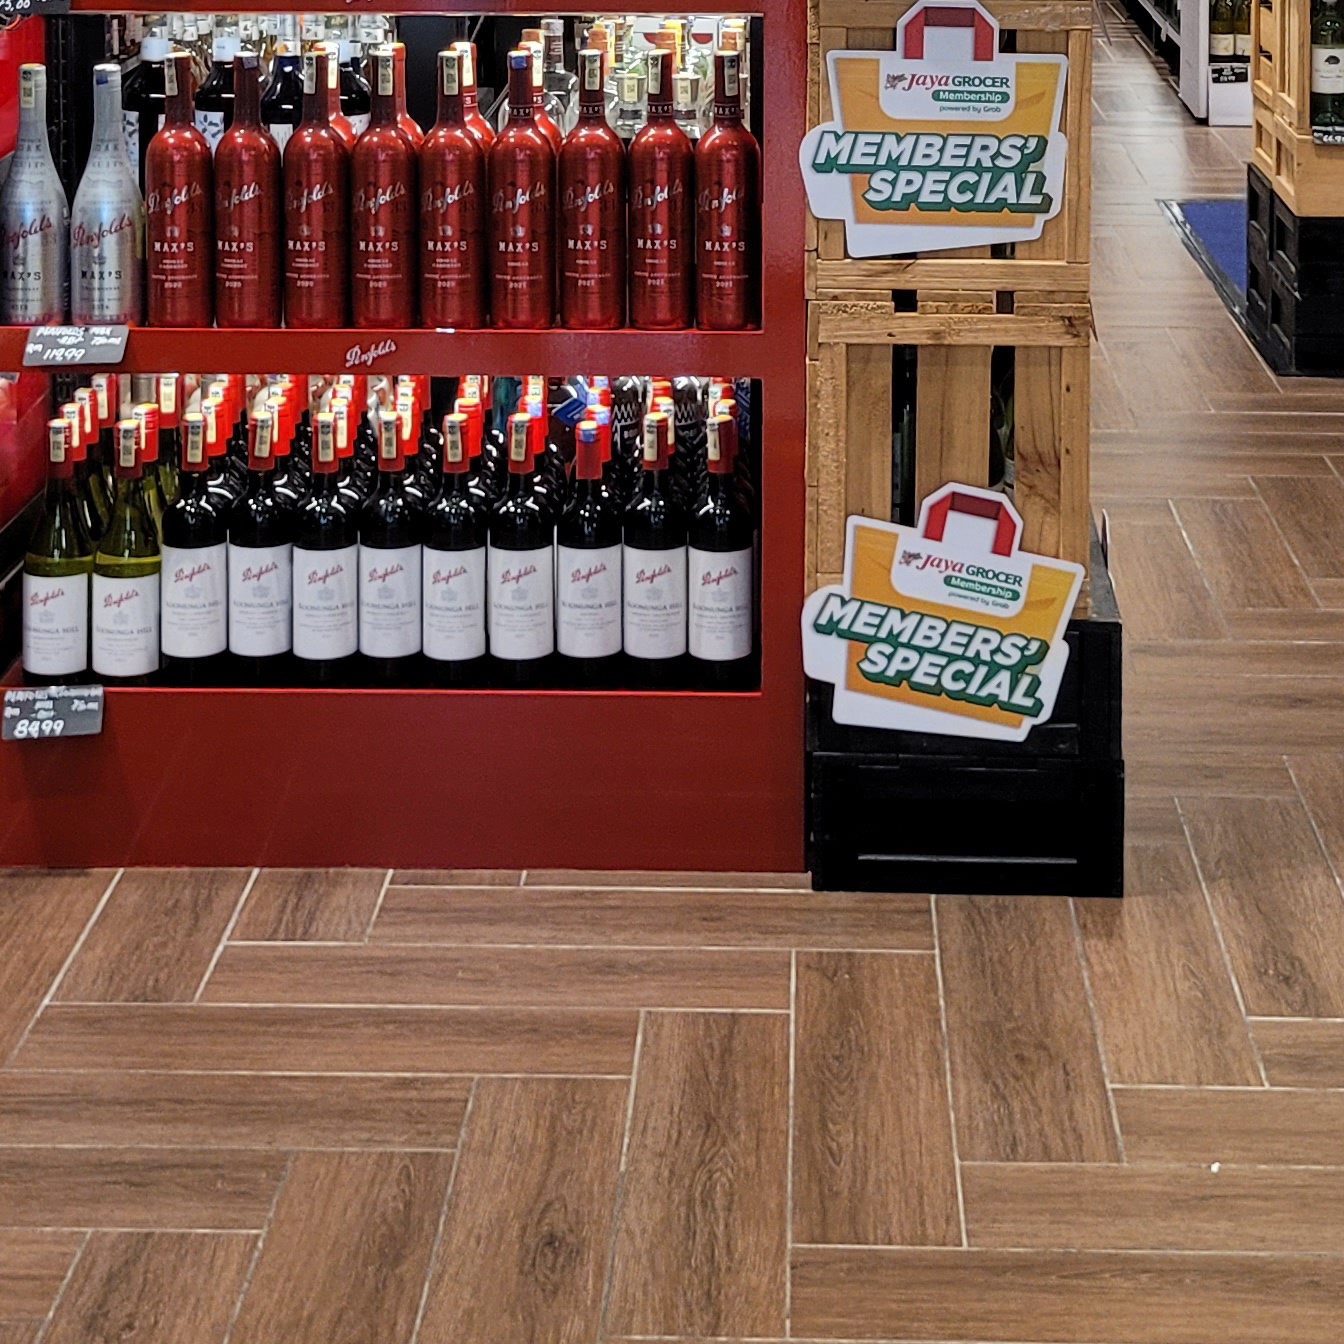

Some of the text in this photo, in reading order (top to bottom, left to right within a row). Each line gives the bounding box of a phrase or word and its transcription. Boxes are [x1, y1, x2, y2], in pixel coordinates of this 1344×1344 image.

[903, 72, 1010, 91] Jaya GROCER
[939, 91, 1002, 102] Membership
[983, 105, 1001, 113] Grab
[863, 170, 1044, 204] SPECIAL
[499, 241, 539, 252] MAX'S
[568, 239, 607, 251] MAX'S
[705, 240, 745, 252] MAX'S
[919, 552, 1023, 587] Jaya GROCER
[951, 577, 1012, 599] Membership
[859, 641, 1037, 708] SPECIAL
